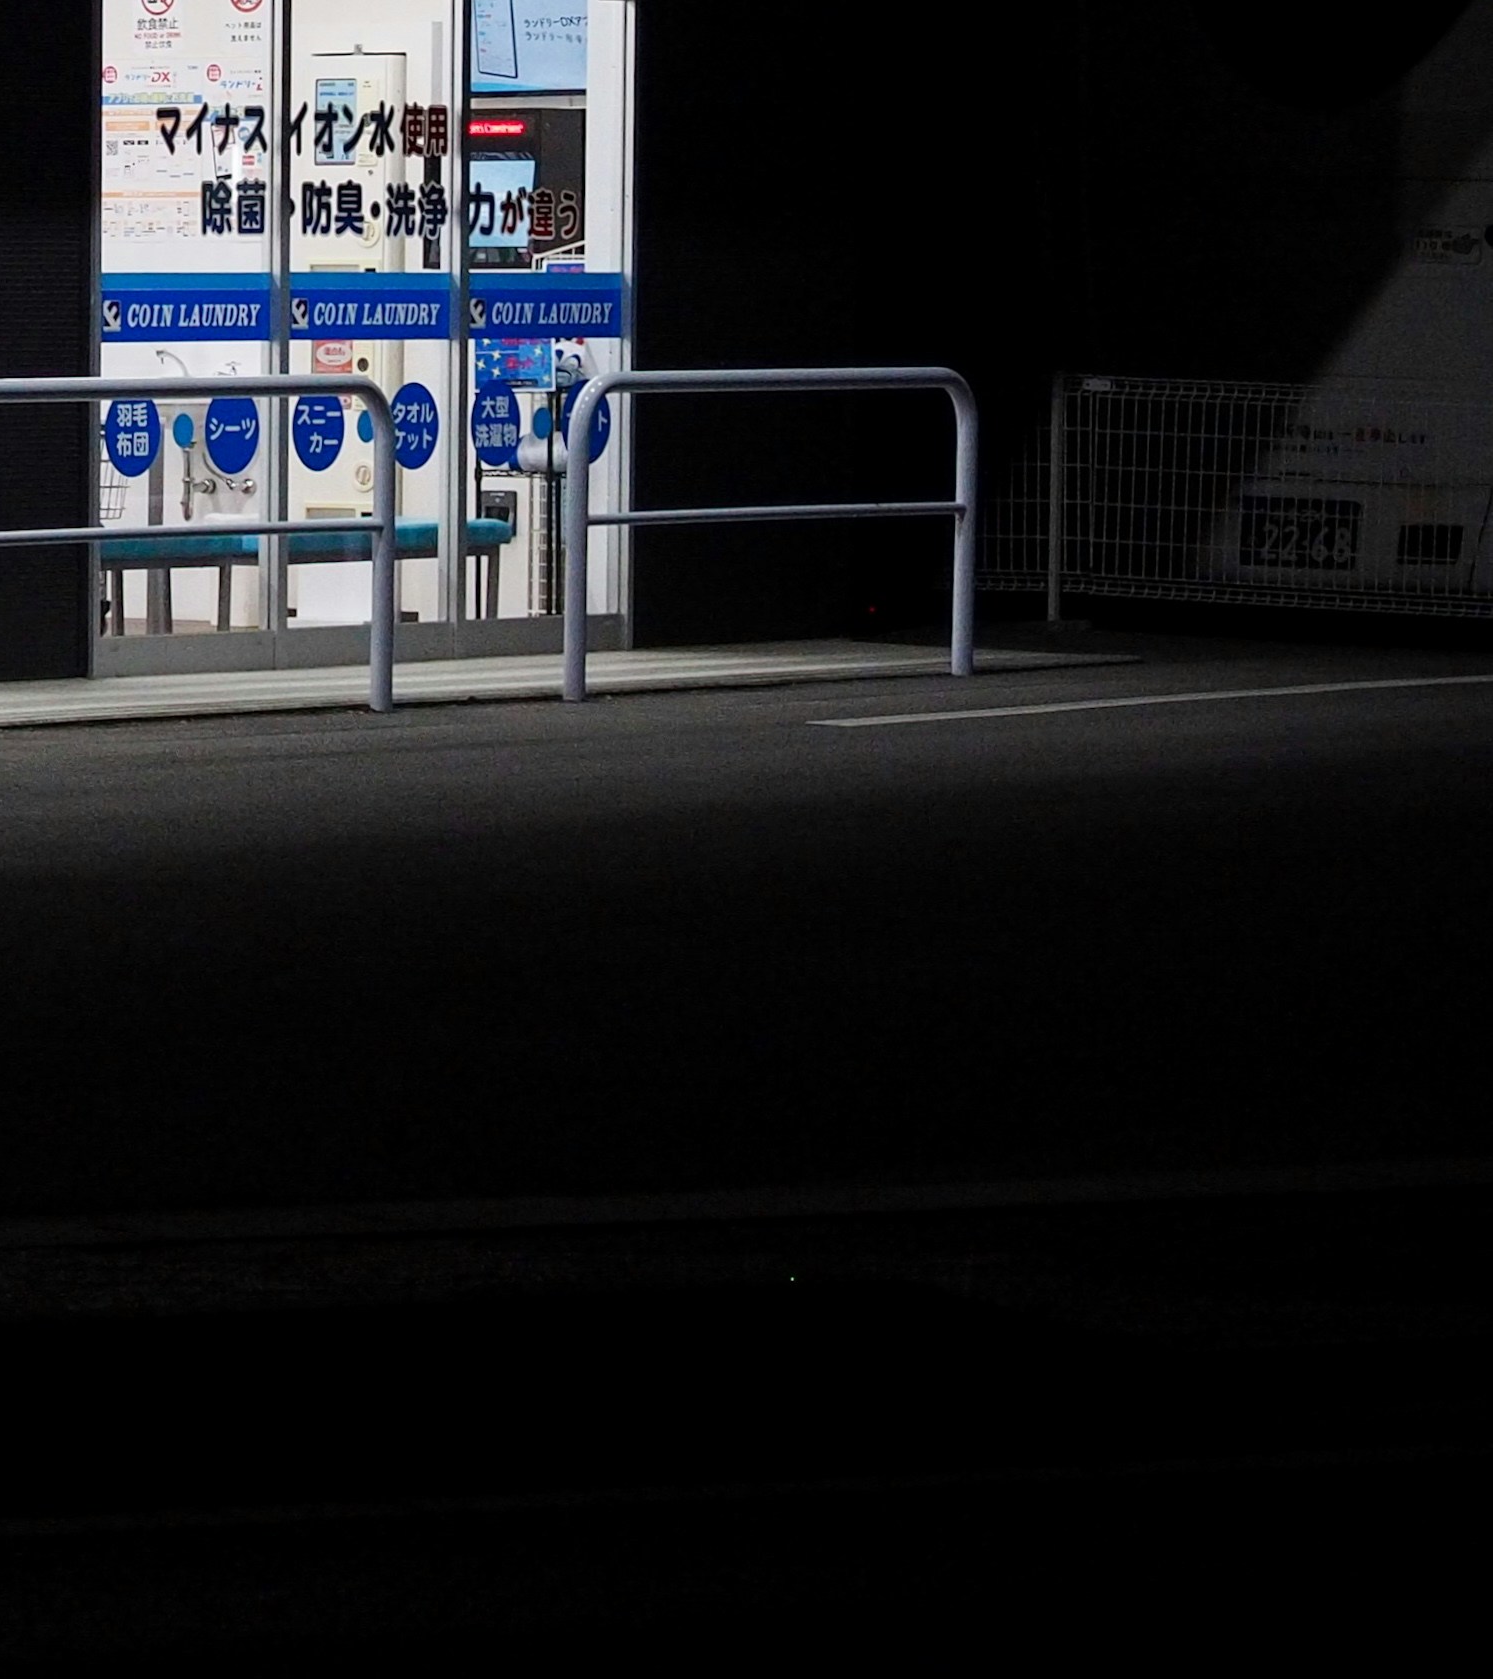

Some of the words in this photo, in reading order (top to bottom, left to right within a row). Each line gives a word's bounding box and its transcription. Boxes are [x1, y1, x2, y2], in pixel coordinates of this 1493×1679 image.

[136, 18, 179, 31] 飲食禁止
[155, 100, 448, 158] マイナスイオン水使用
[201, 180, 580, 241] 除菌・防臭・洗浄力が違う
[127, 303, 174, 328] COIN
[177, 303, 261, 328] LAUNDRY
[314, 302, 358, 326] COIN
[361, 303, 441, 326] LAUNDRY
[491, 301, 535, 326] COIN
[537, 302, 613, 325] LAUNDRY
[116, 403, 149, 428] 羽毛
[297, 404, 342, 426] スニー
[392, 402, 435, 425] タオル
[481, 396, 510, 419] 大型
[209, 417, 257, 441] シーツ
[395, 429, 433, 450] ケット
[475, 424, 518, 449] 洗濯物
[116, 432, 150, 458] 布団
[309, 432, 339, 454] カー
